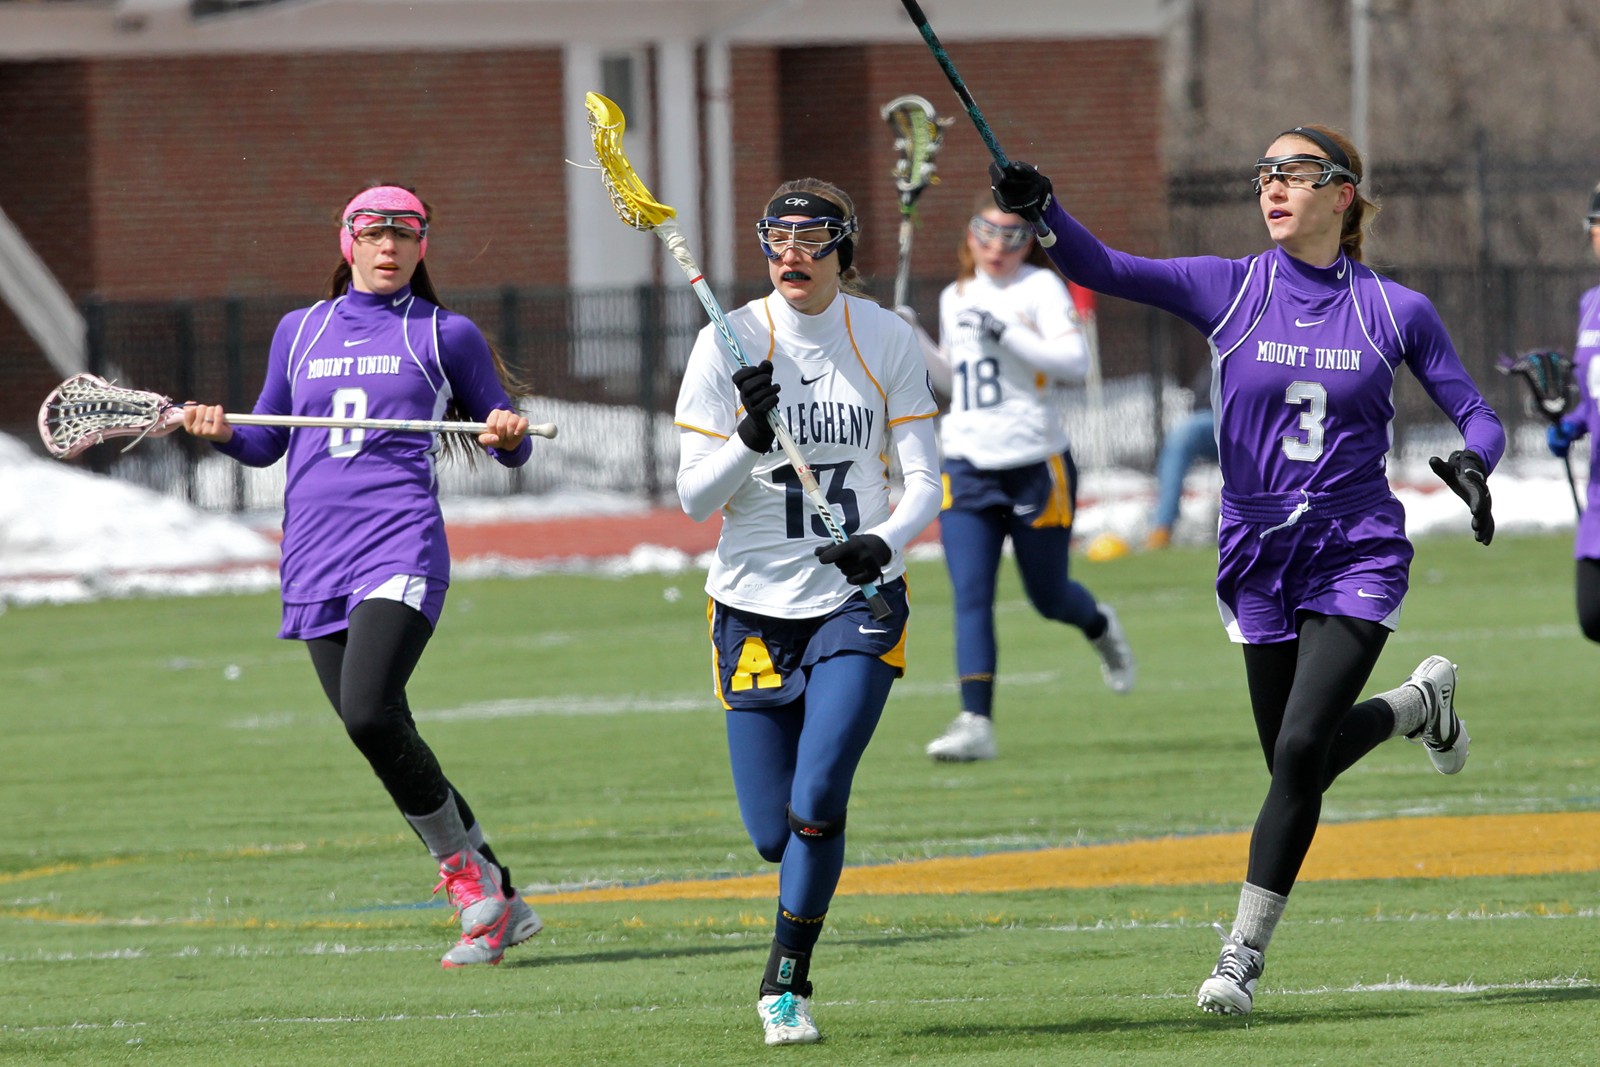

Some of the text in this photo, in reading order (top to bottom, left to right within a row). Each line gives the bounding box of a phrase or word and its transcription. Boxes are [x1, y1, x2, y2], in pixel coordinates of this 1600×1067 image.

[307, 355, 401, 379] MOUNT UNION
[1256, 341, 1362, 371] MOUNT UNION
[955, 358, 1002, 411] 18
[328, 387, 368, 458] 0
[1281, 380, 1327, 462] 3
[771, 460, 860, 539] 13
[731, 636, 782, 692] A
